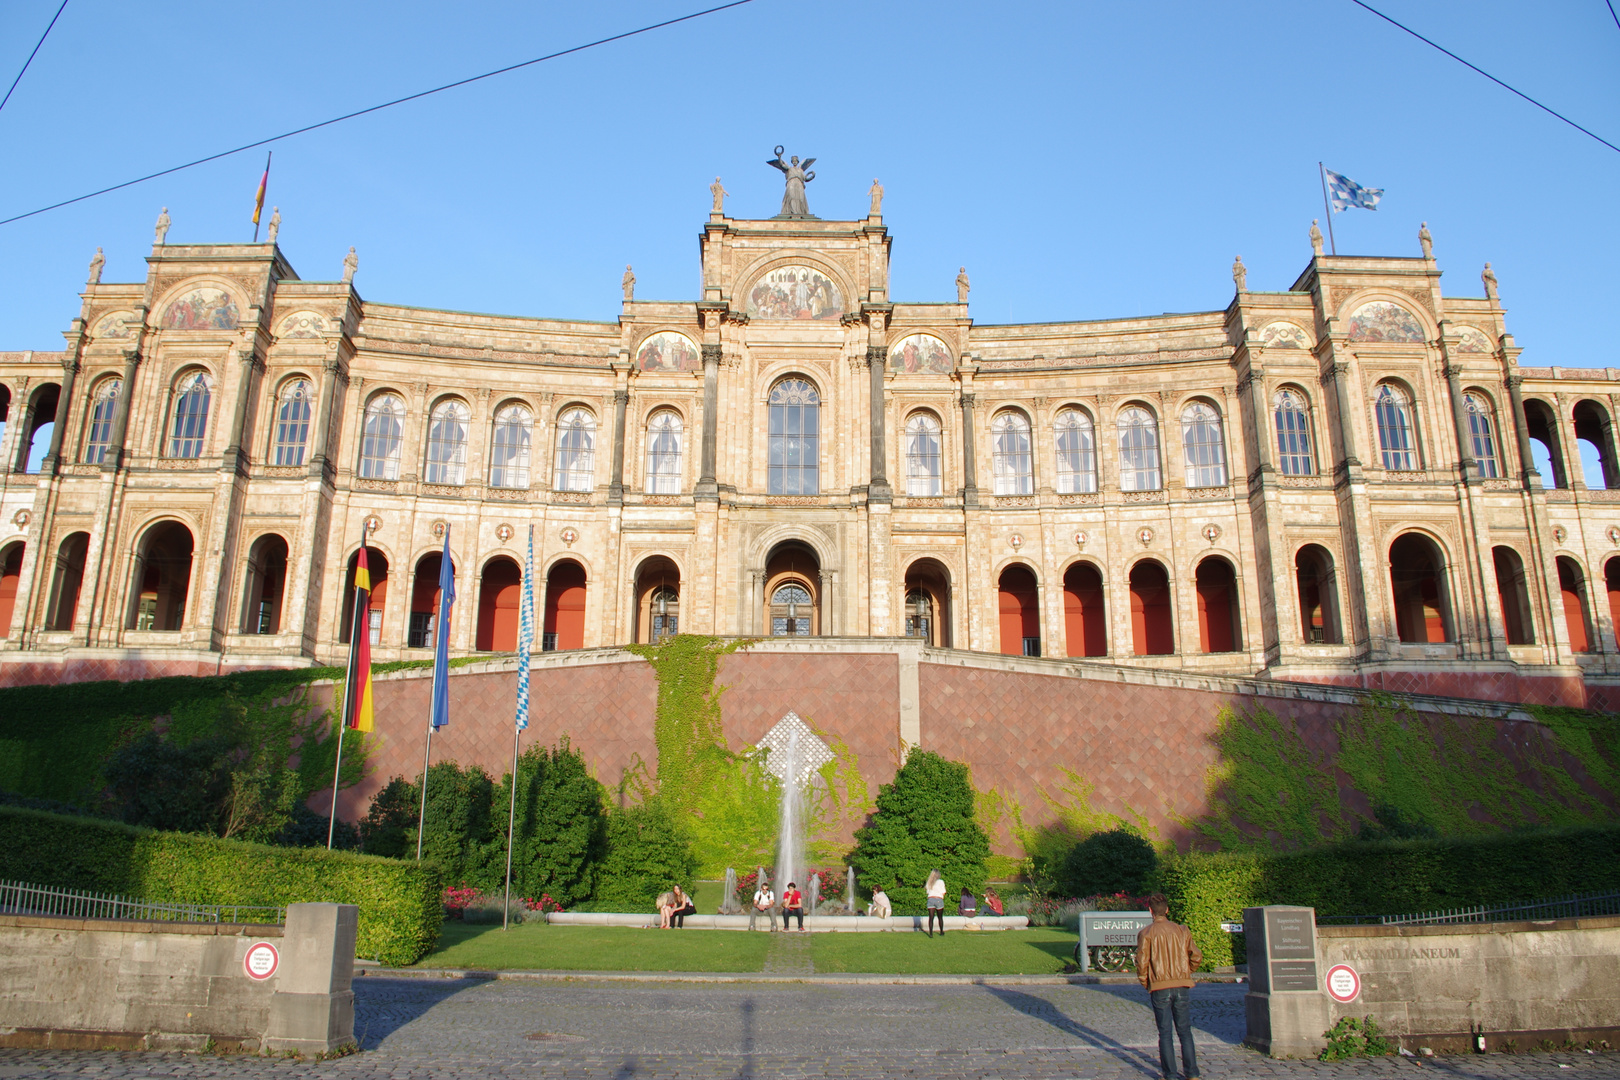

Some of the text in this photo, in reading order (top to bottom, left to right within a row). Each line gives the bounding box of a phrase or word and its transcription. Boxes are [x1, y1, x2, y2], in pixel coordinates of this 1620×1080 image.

[1093, 920, 1134, 930] EINFAHRT
[1104, 934, 1136, 943] BESETZT
[1341, 948, 1461, 960] MAXIMILIANEUM
